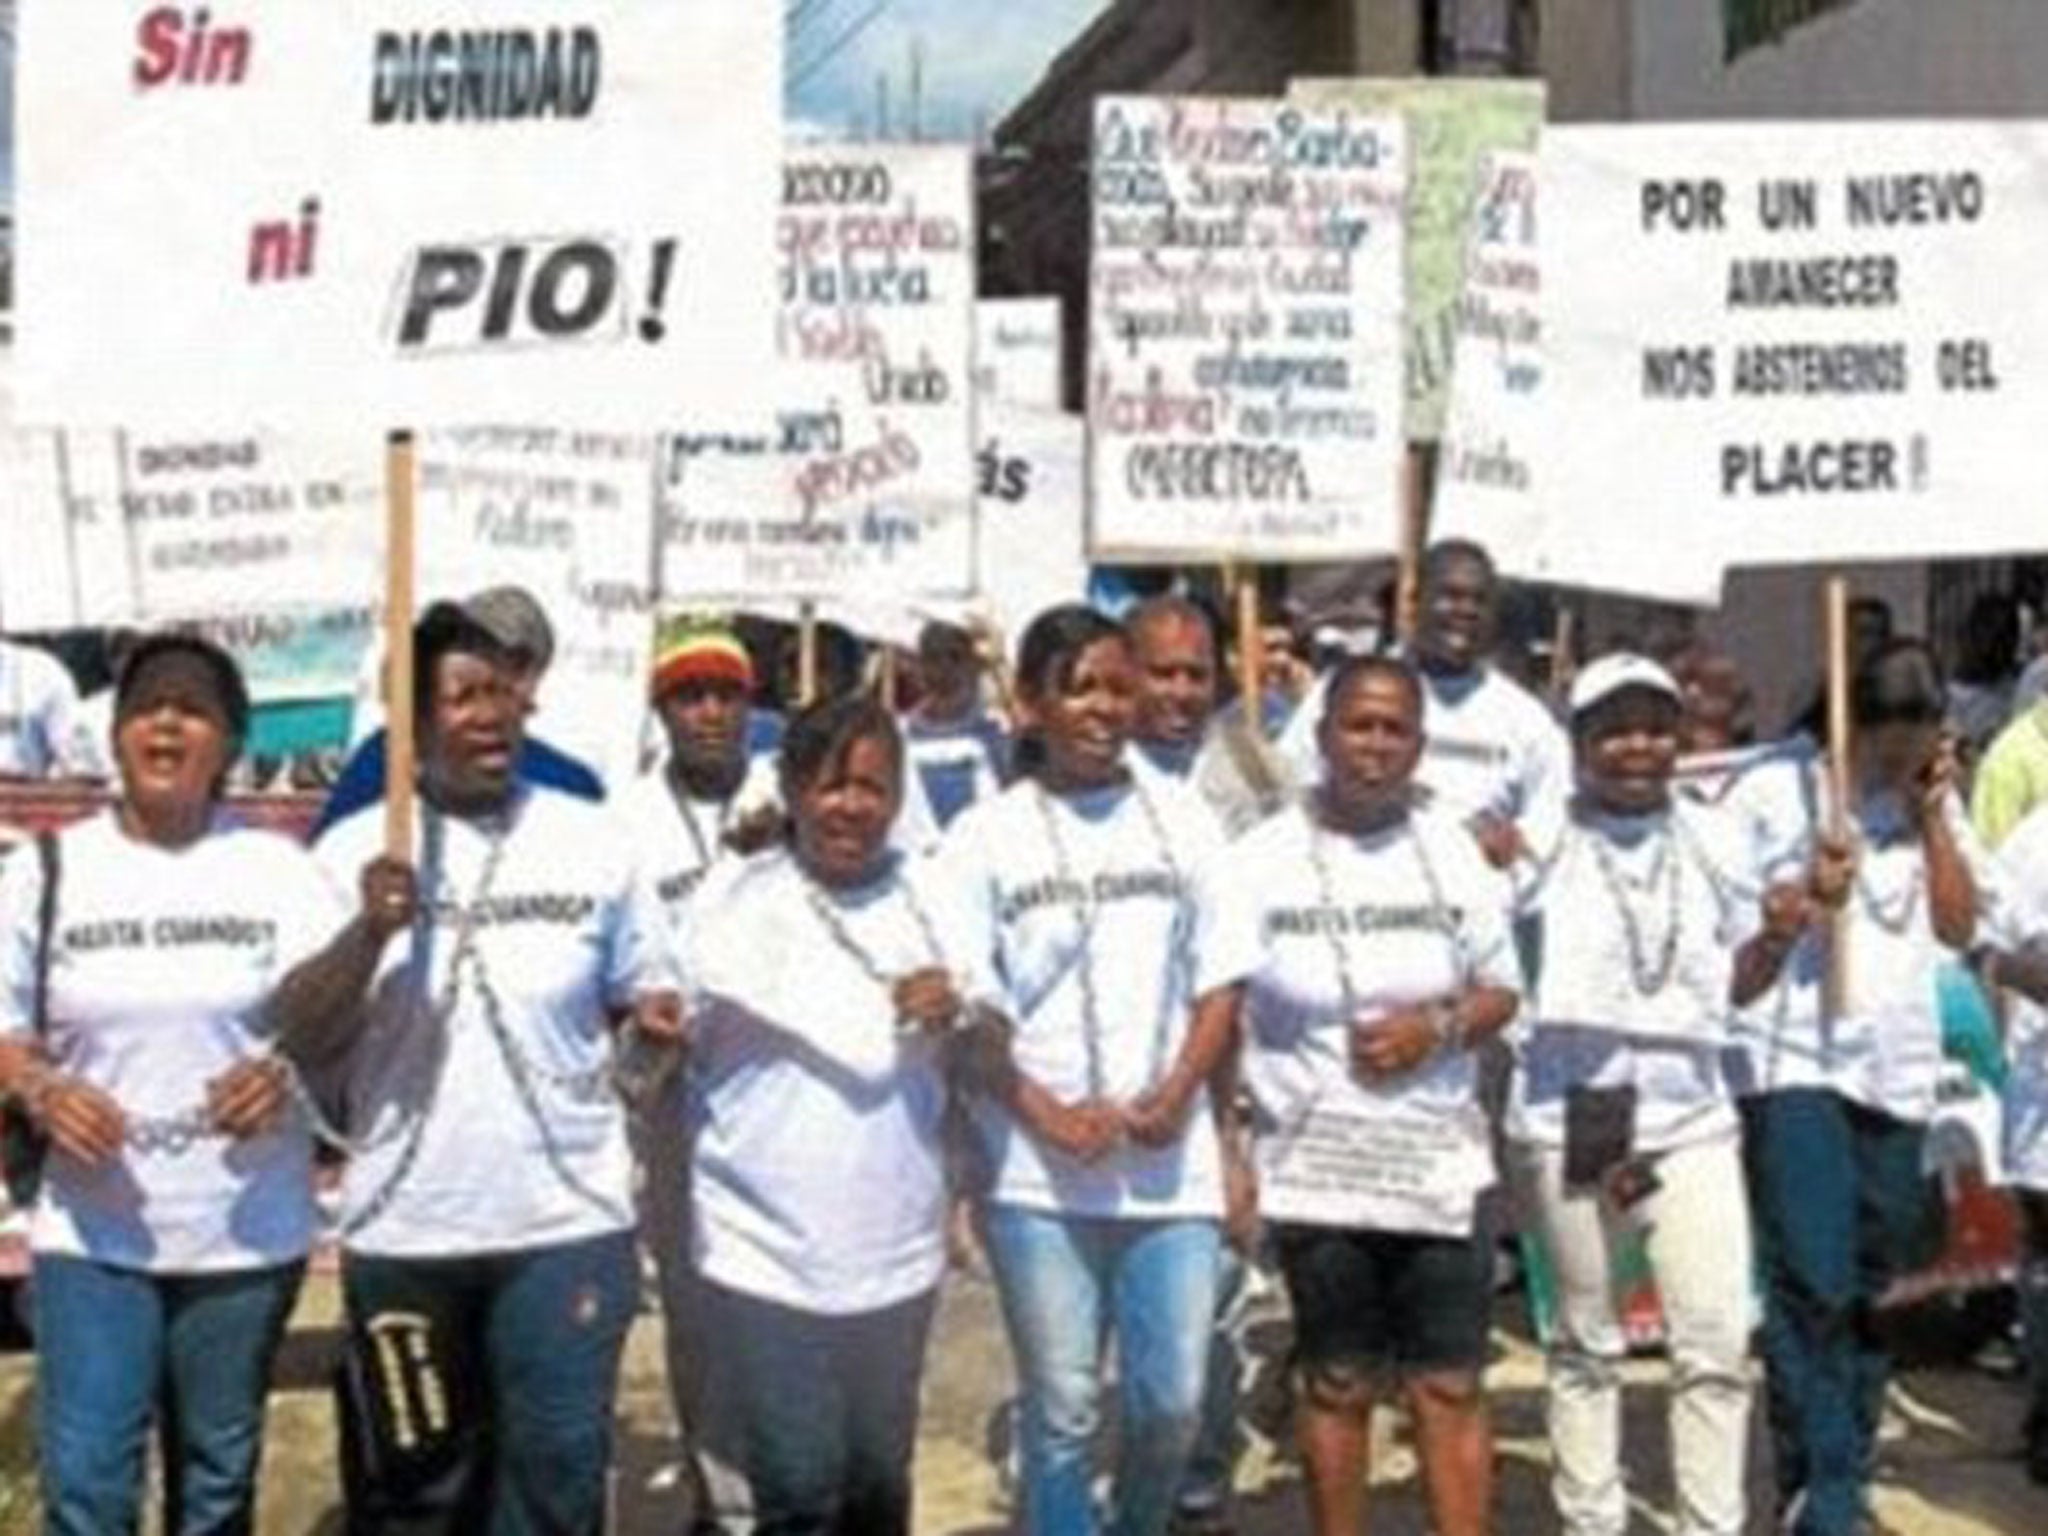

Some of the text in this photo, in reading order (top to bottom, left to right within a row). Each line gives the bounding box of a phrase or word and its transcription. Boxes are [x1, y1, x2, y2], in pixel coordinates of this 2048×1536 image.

[134, 6, 600, 124] Sin DIGNIDAD
[1641, 171, 1983, 231] POR UN NUEVO
[249, 199, 320, 283] ni
[400, 242, 617, 345] PIO
[1727, 254, 1899, 309] AMANECER
[1642, 339, 1998, 399] NOS ABSTENEMOS DEL
[1720, 439, 1898, 496] PLACER
